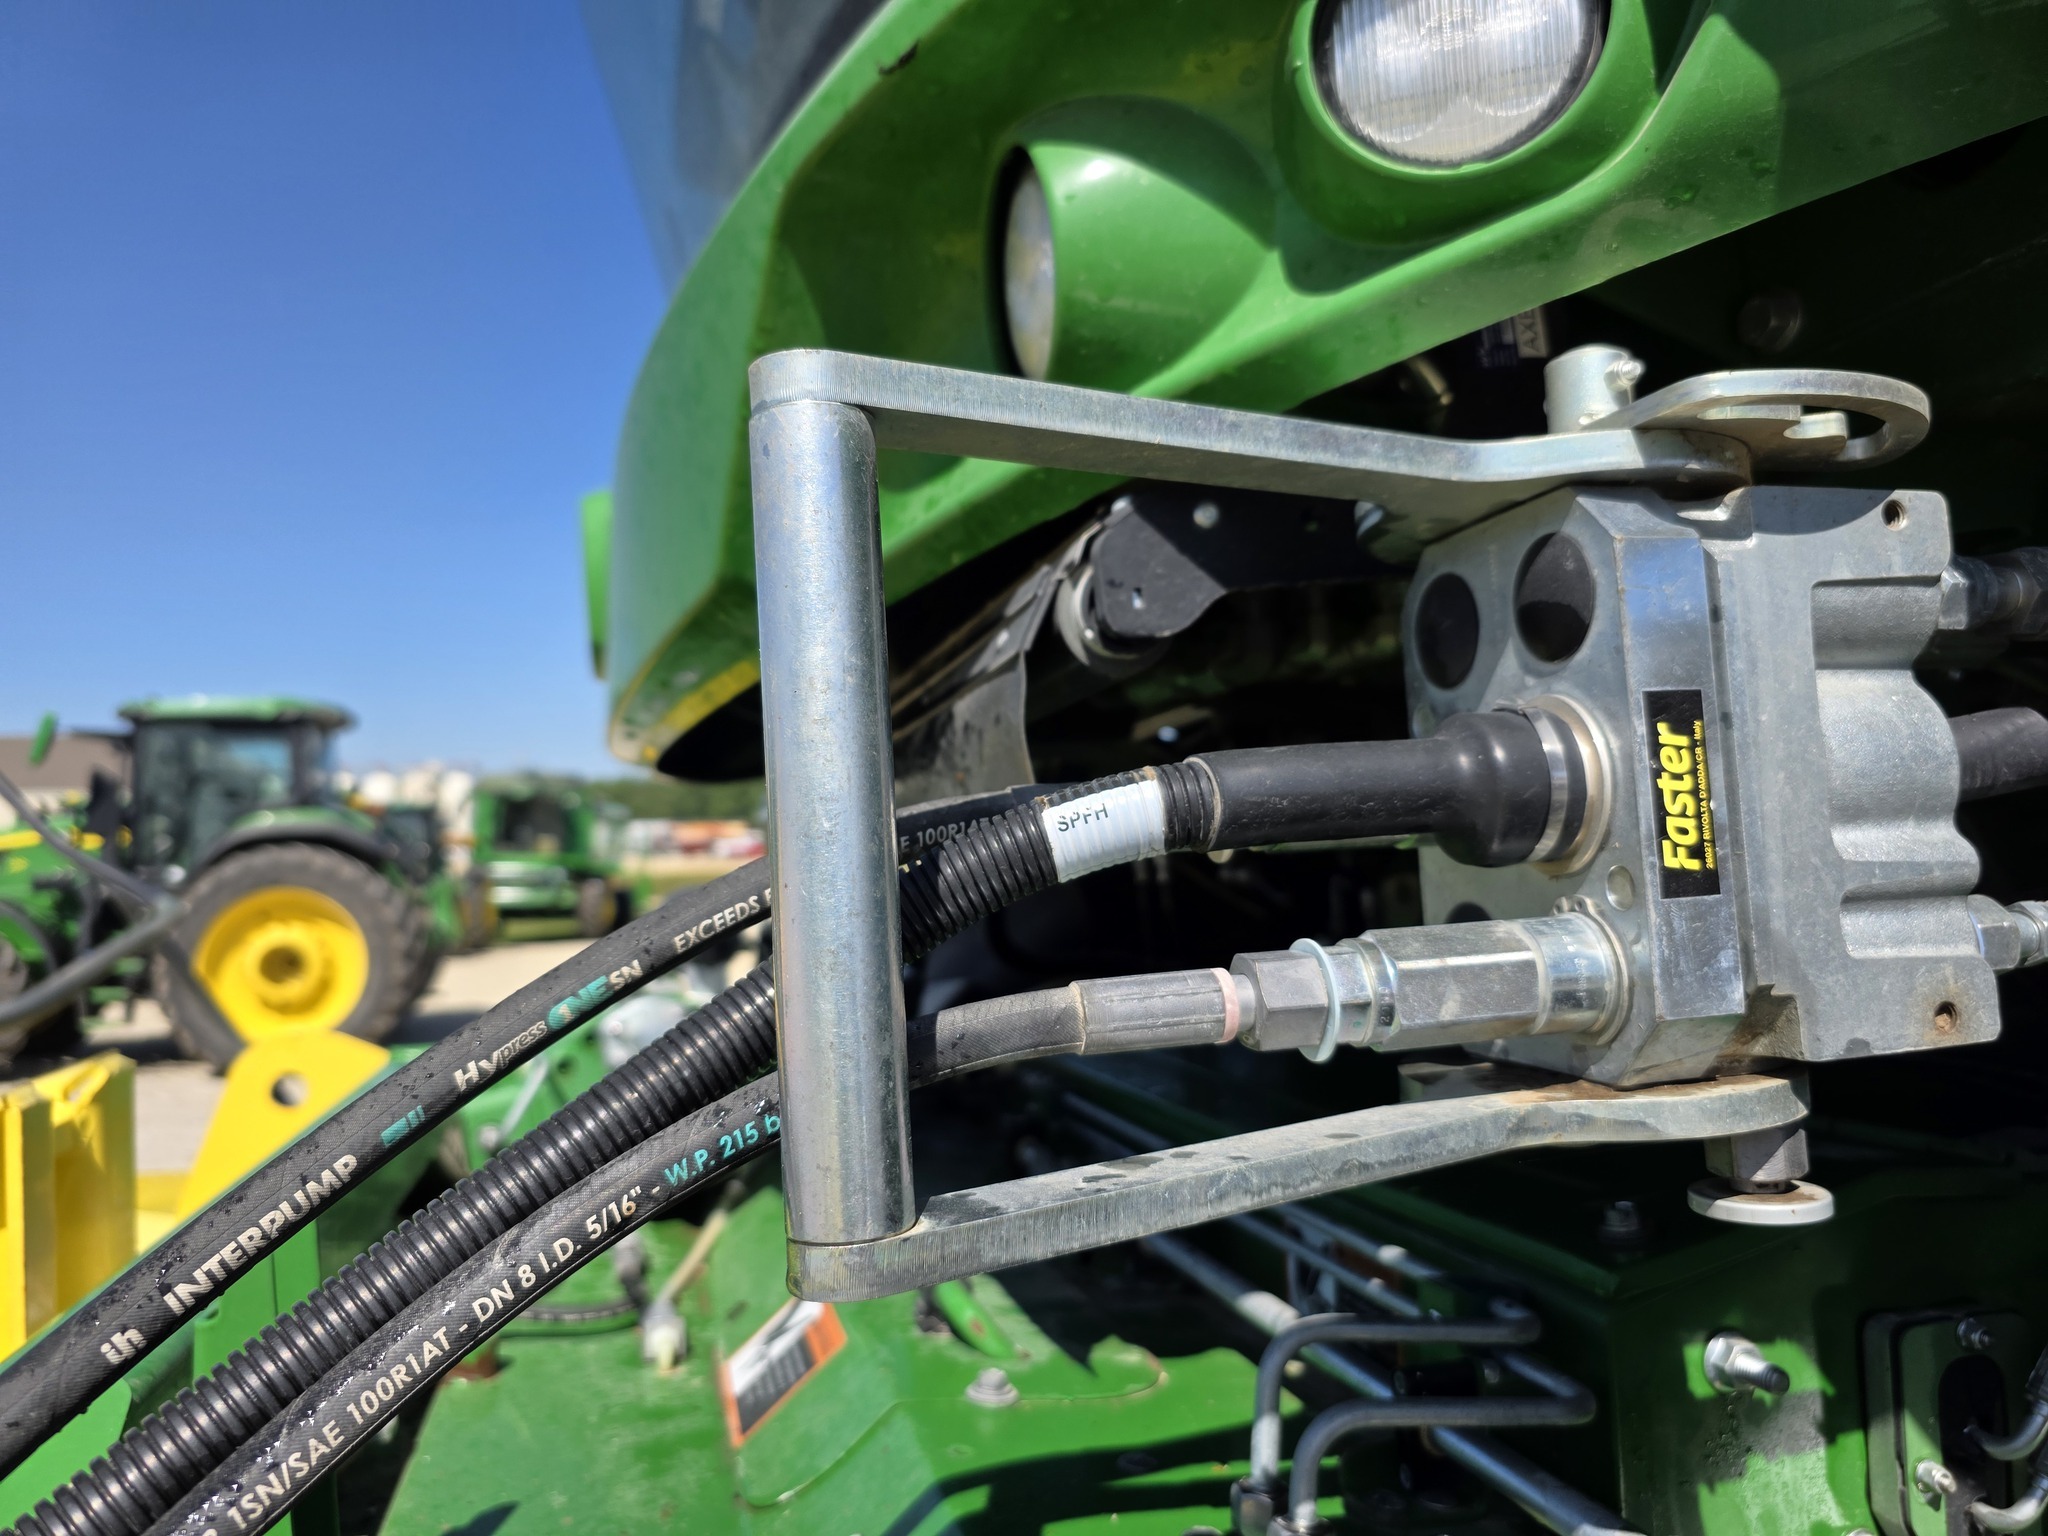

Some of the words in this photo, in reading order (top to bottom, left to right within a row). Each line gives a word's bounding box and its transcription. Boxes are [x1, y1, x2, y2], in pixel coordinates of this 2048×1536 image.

[1693, 720, 1702, 742] Italy
[1656, 721, 1702, 871] Faster
[1057, 803, 1109, 832] SPFH
[1700, 799, 1712, 839] RIVOLTA
[1705, 841, 1714, 869] 26027
[162, 1154, 358, 1317] INTERPUMP
[454, 1020, 548, 1092] Hypress
[609, 959, 644, 991] SN
[674, 895, 761, 953] EXCEEDS
[227, 1420, 345, 1530] 1SN/SAE
[346, 1326, 451, 1425] 100R1AT
[471, 1279, 515, 1323] DN
[517, 1264, 536, 1288] 8
[538, 1237, 582, 1273] I.D.
[586, 1186, 642, 1240] 5/16"
[664, 1149, 715, 1187] W.P.
[719, 1121, 759, 1159] 215
